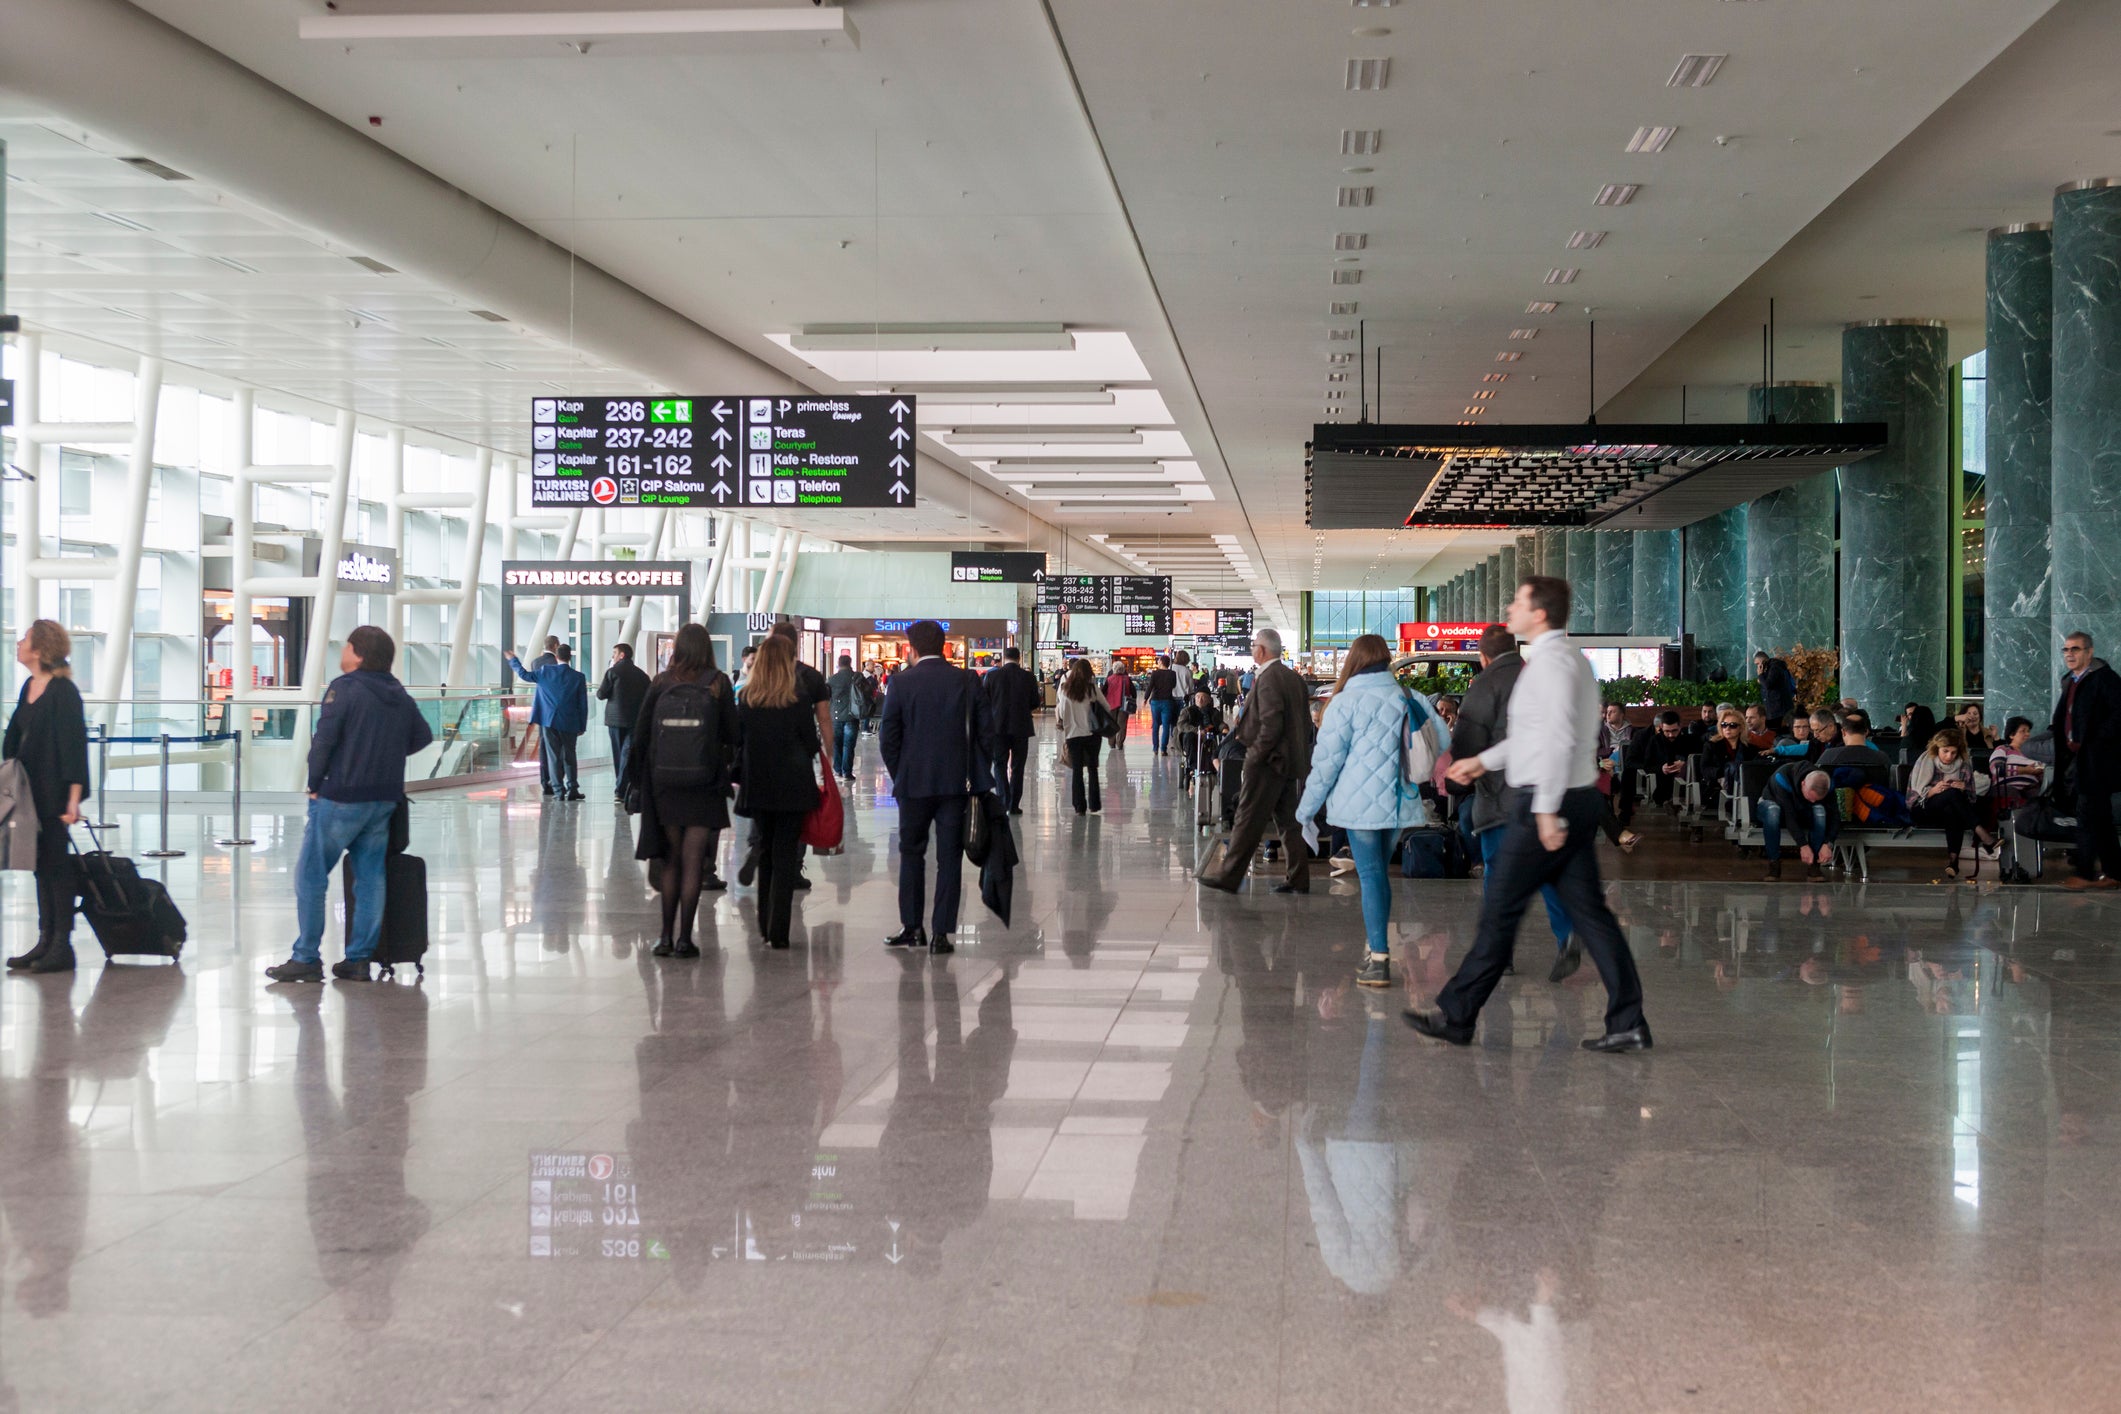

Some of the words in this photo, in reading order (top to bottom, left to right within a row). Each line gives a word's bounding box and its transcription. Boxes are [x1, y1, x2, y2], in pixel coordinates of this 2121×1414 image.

[558, 400, 584, 413] Kapı
[605, 402, 645, 422] 236
[797, 400, 849, 414] primeclass
[558, 415, 578, 423] Gate
[832, 412, 862, 422] lounge
[558, 427, 598, 440] Kapılar
[605, 428, 692, 448] 237-242
[774, 427, 806, 438] Teras
[558, 442, 582, 450] Gates
[774, 442, 816, 451] Courtyard
[774, 454, 798, 464] Kafe
[810, 454, 858, 464] Restoran
[558, 454, 598, 467] Kapılar
[605, 455, 692, 475] 161-162
[558, 468, 582, 476] Gates
[774, 468, 794, 476] Cafe
[802, 468, 847, 476] Restaurant
[534, 480, 589, 491] TURKISH
[641, 480, 662, 492] CIP
[665, 480, 704, 492] Salonu
[798, 480, 840, 492] Telefon
[534, 491, 590, 502] AIRLINES
[642, 495, 657, 503] CIP
[658, 495, 690, 504] Lounge
[799, 494, 842, 504] Telephone
[505, 570, 613, 585] STARBUCKS
[615, 571, 683, 586] COFFEE
[1063, 586, 1094, 594] 238-242
[1442, 626, 1483, 636] vodafone
